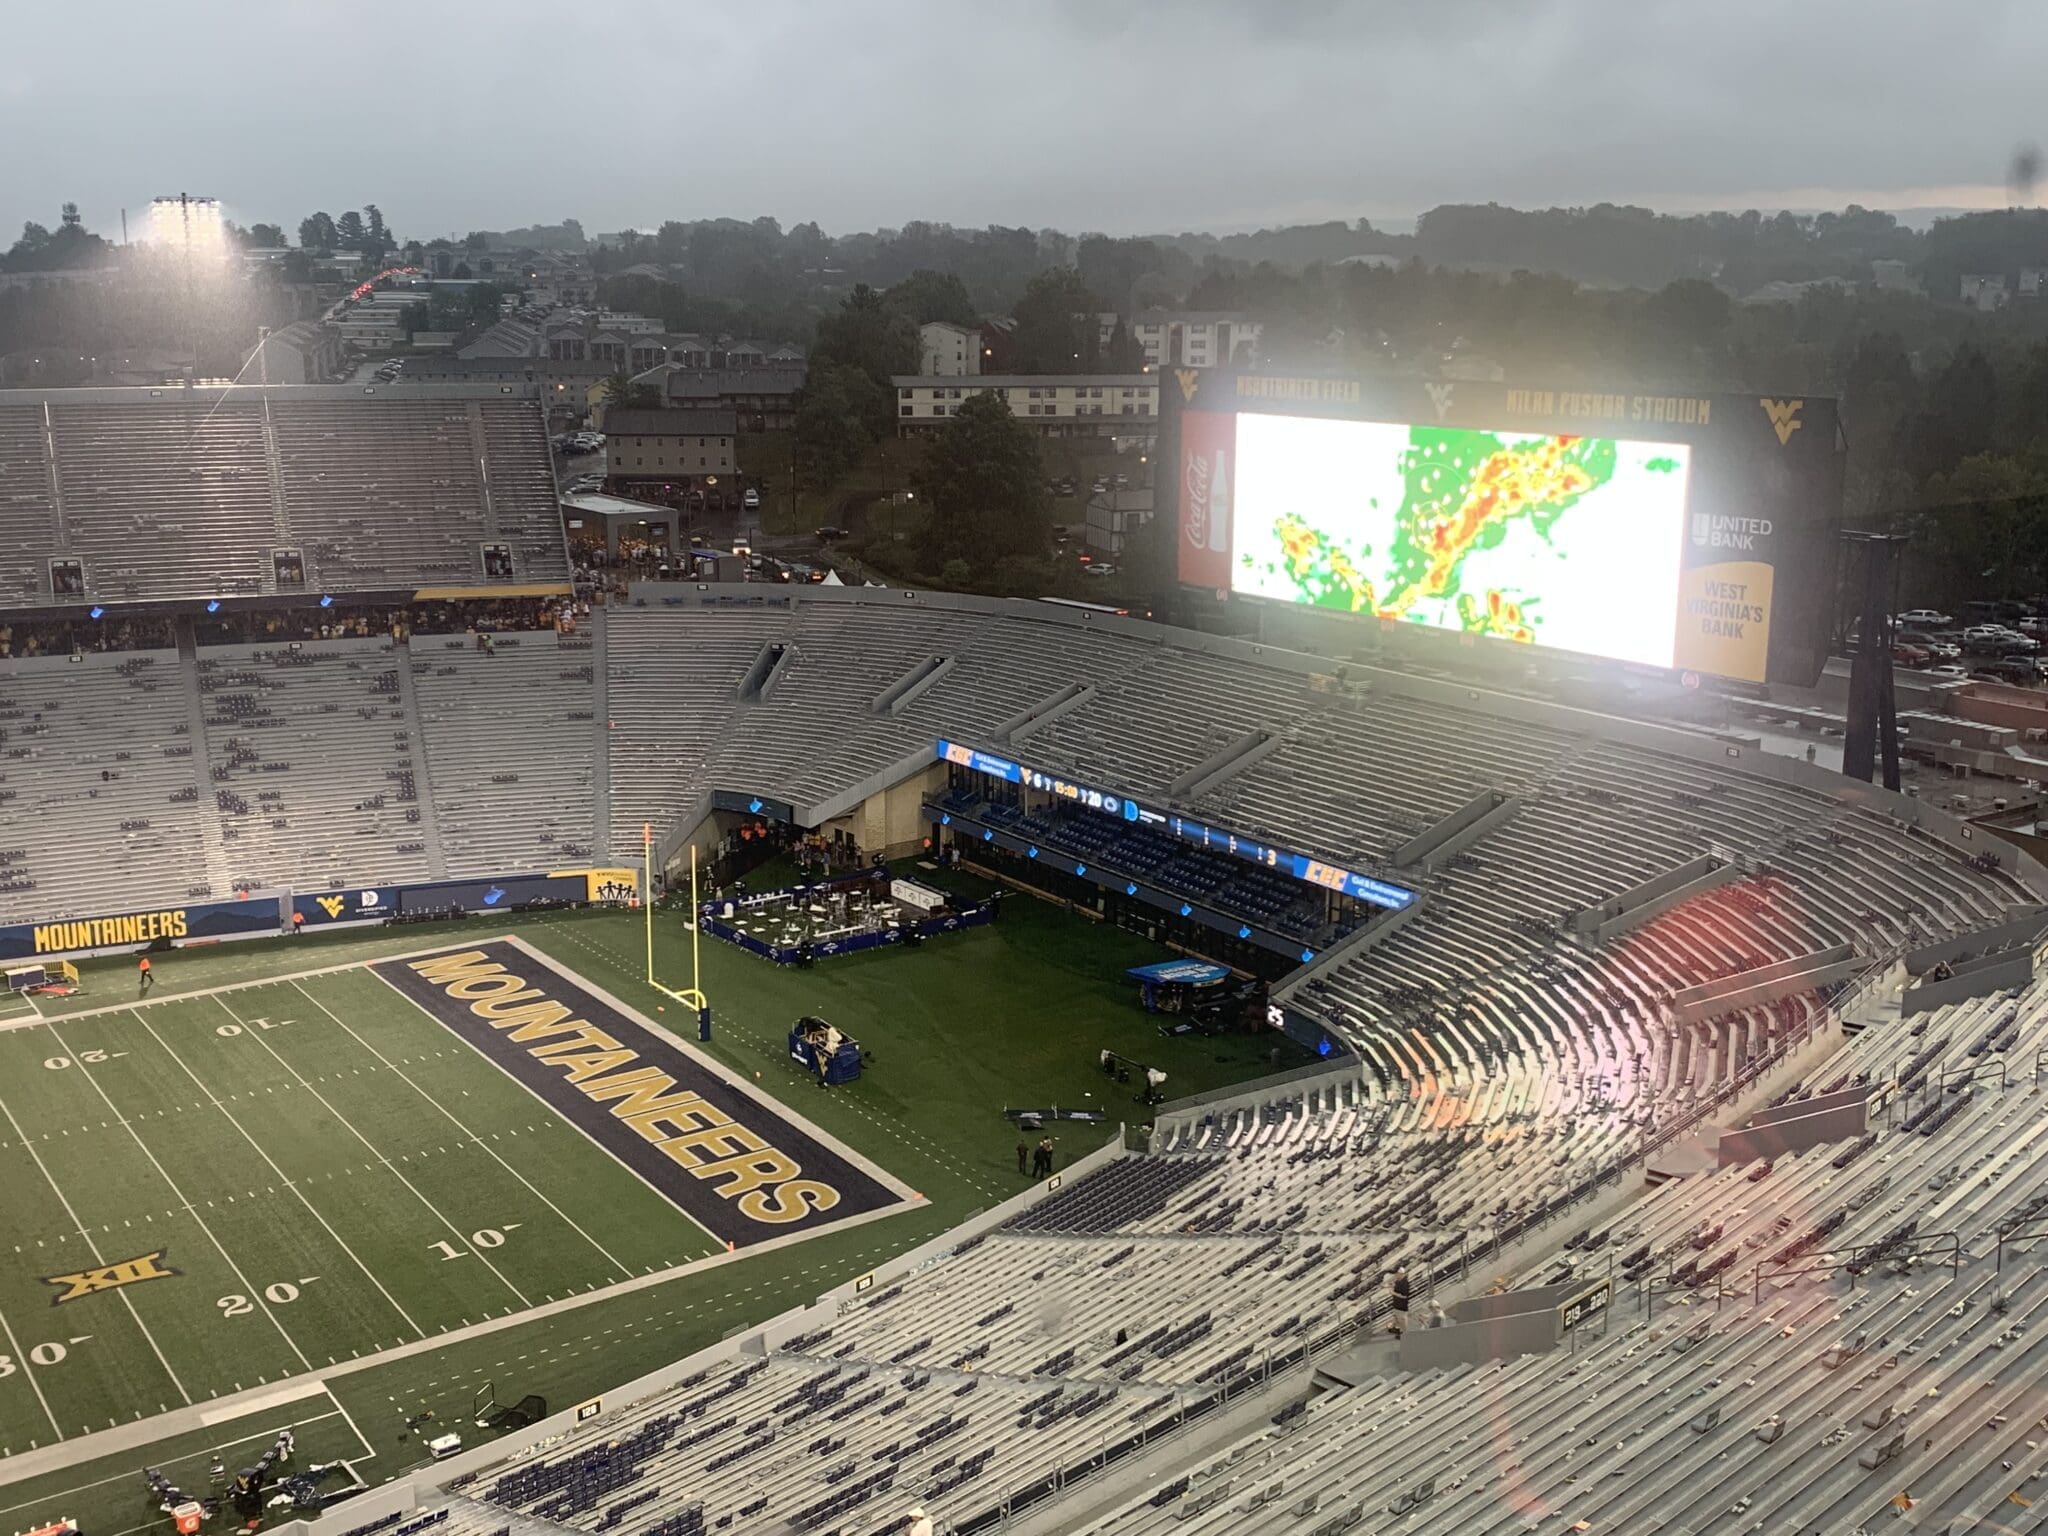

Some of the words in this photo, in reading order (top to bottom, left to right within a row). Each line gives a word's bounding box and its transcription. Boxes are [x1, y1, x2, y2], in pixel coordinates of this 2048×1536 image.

[1632, 395, 1711, 425] STADIUM
[1712, 514, 1772, 536] UNITED
[1711, 532, 1754, 550] BANK
[1704, 581, 1748, 601] WEST
[1686, 598, 1763, 623] VIRGINIA'S
[1701, 618, 1744, 639] BANK
[1033, 773, 1042, 788] 6
[34, 910, 188, 953] MOUNTAINEERS
[1267, 1004, 1284, 1026] 25
[408, 950, 842, 1224] MOUNTAINEERS
[427, 1228, 507, 1262] 10
[217, 1281, 300, 1318] 20
